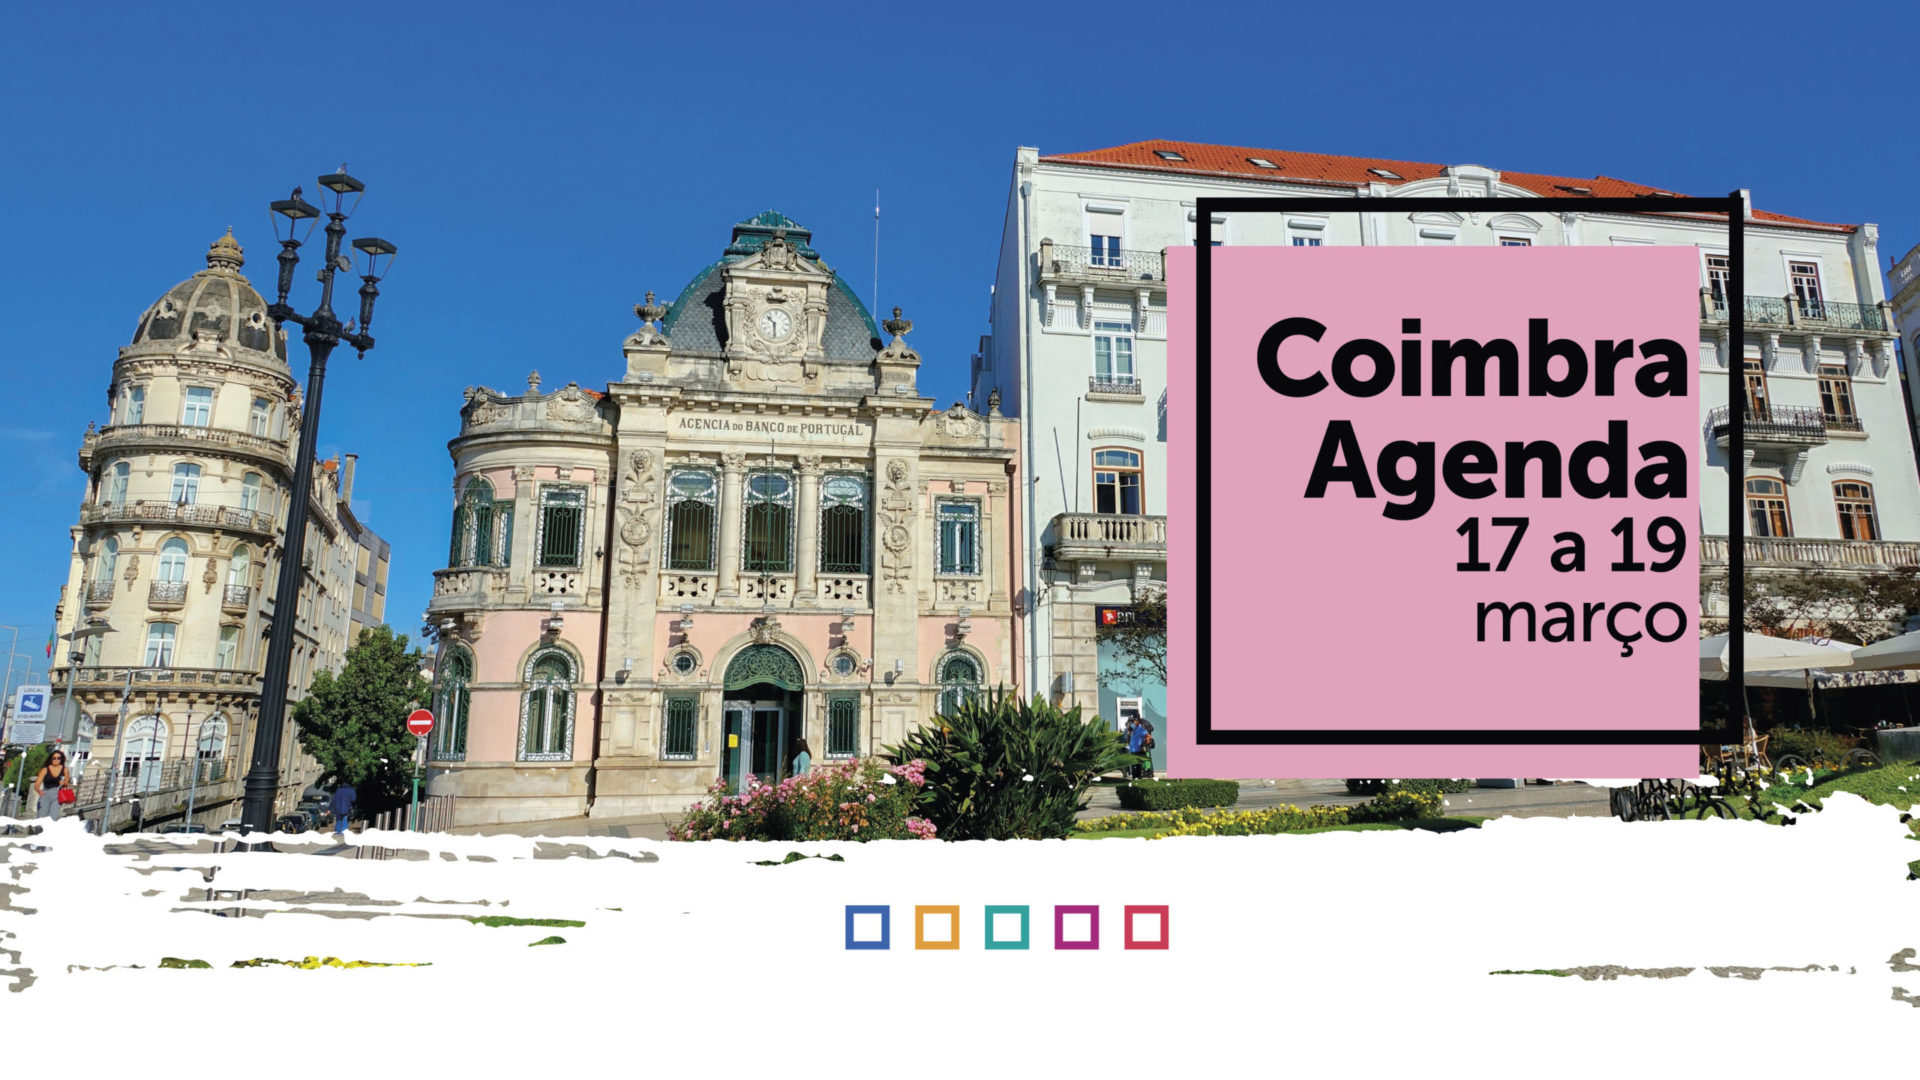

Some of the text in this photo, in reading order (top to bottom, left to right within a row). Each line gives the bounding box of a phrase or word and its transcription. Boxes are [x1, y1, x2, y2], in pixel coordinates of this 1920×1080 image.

[679, 418, 864, 436] AGENCIA DO BANCO DE PORTUGAL
